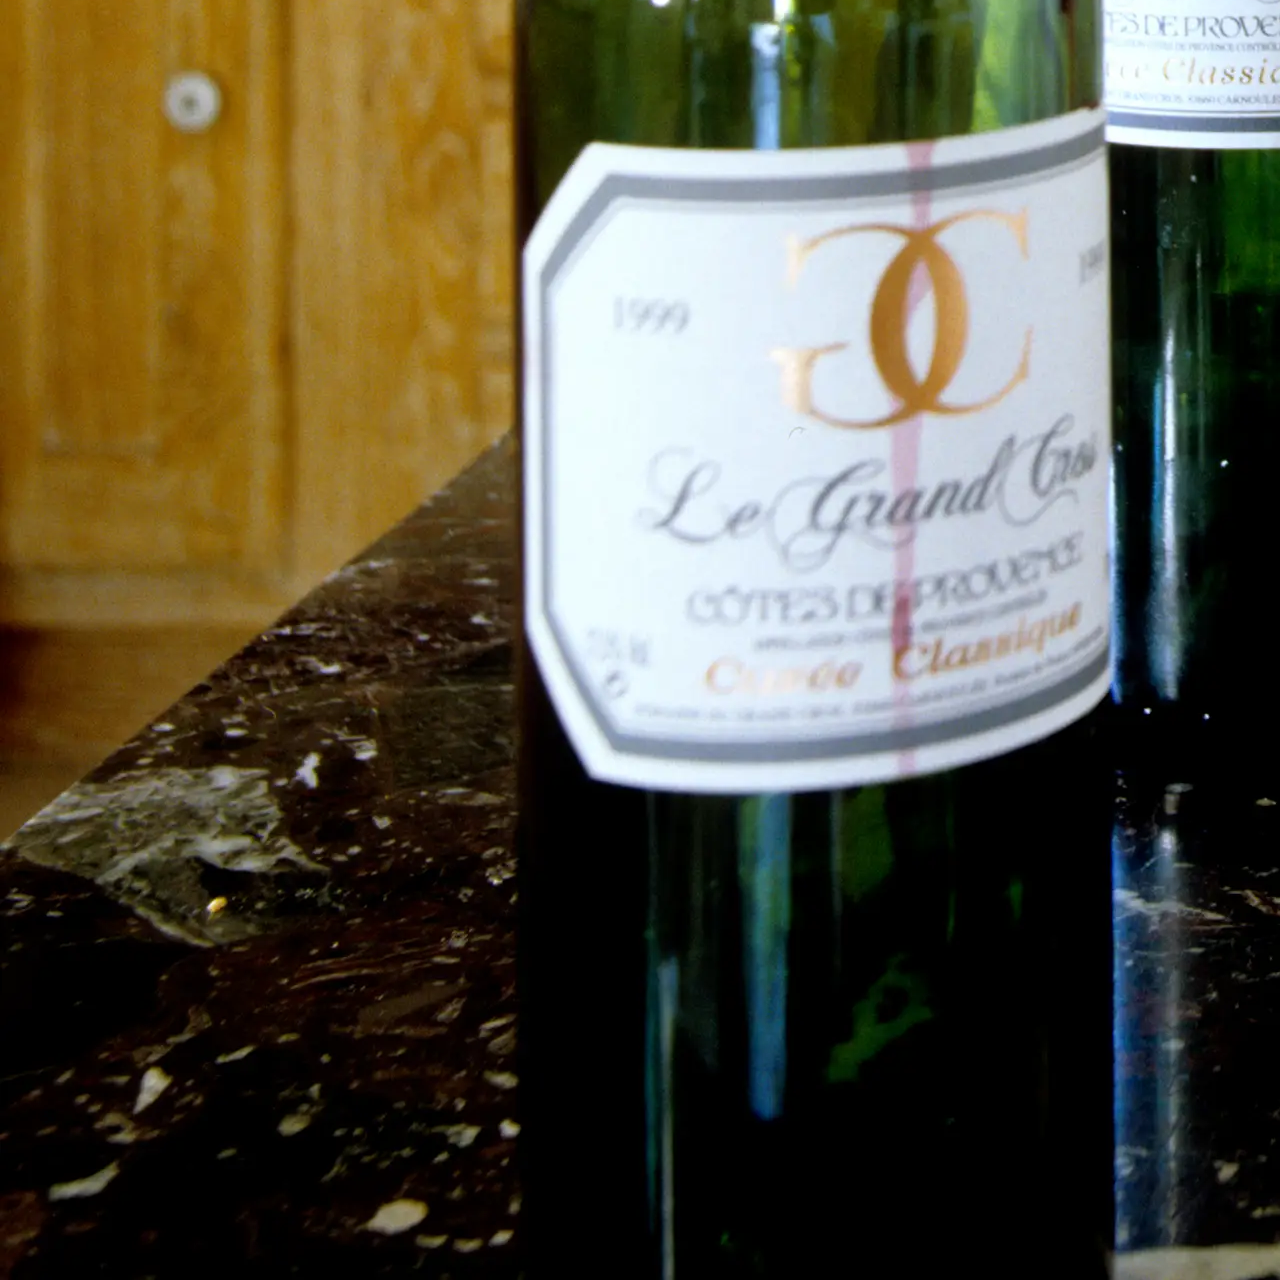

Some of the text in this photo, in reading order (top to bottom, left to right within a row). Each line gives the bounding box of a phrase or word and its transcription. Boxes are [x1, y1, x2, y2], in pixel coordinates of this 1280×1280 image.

[1144, 14, 1178, 37] DE
[612, 294, 691, 334] 1999
[639, 445, 762, 546] Le
[771, 435, 1014, 573] Grand
[908, 531, 1084, 611] PROVENCE
